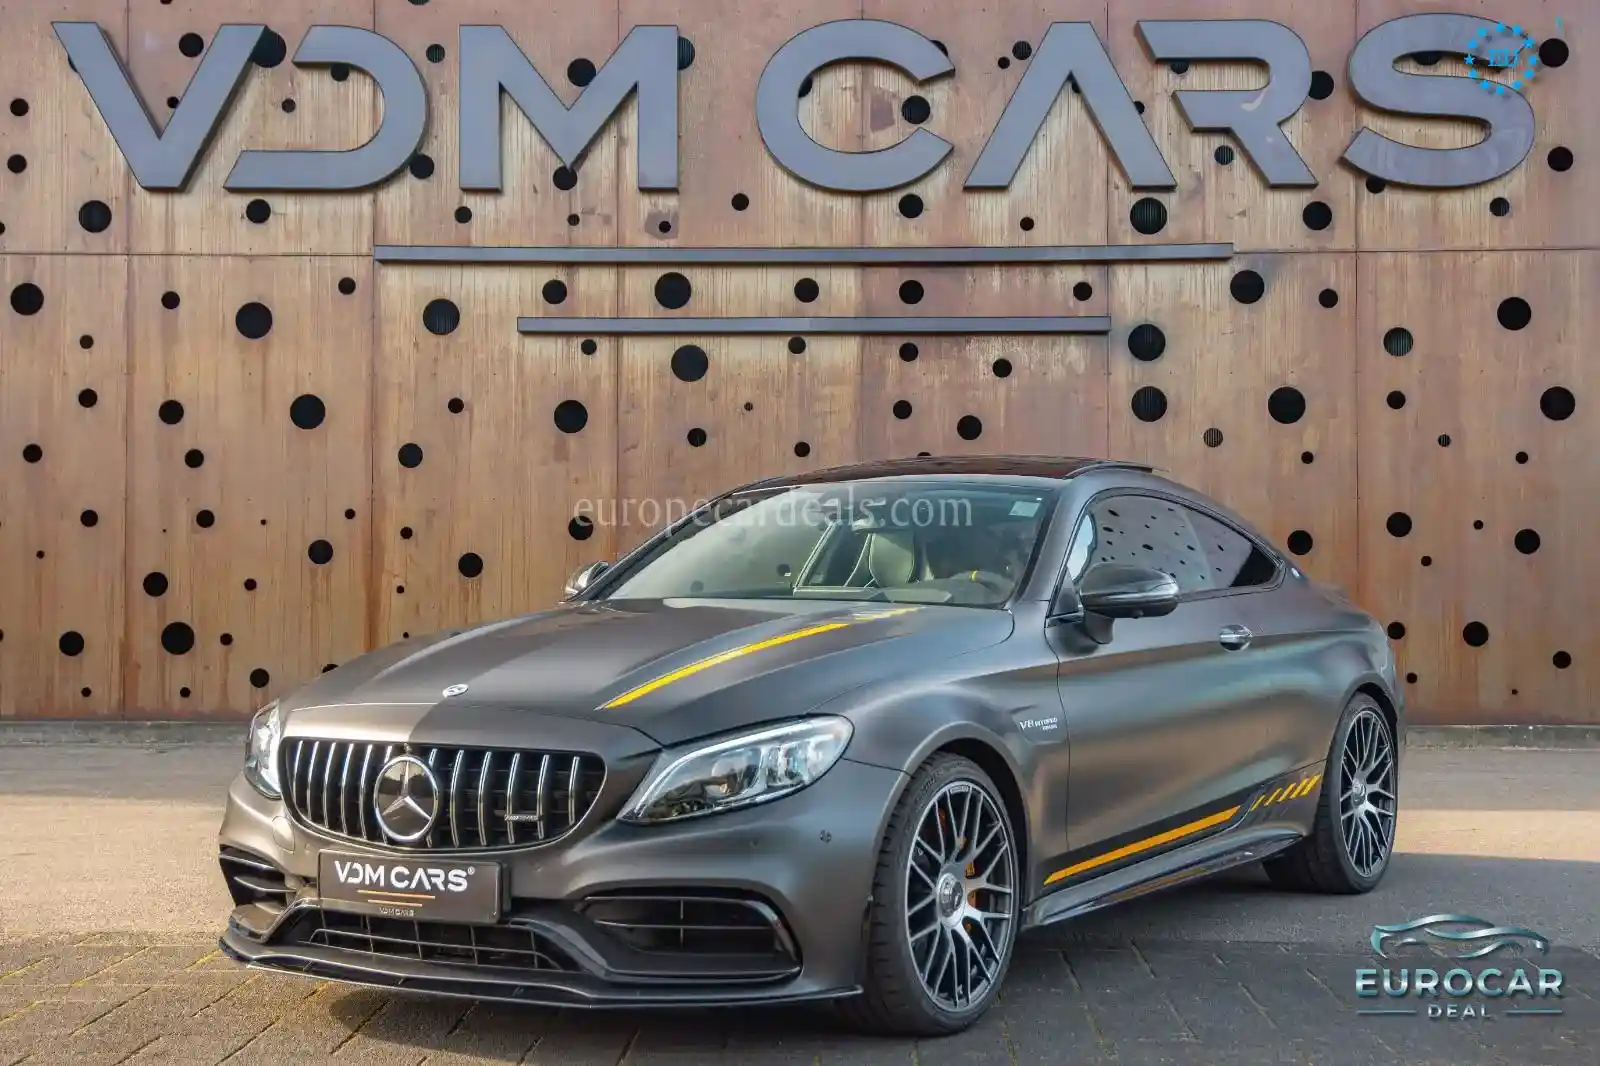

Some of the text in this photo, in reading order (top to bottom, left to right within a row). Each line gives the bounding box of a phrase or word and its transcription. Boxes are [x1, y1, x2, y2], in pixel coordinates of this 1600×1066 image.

[51, 13, 1536, 192] VDM CARS
[334, 860, 385, 887] VDM
